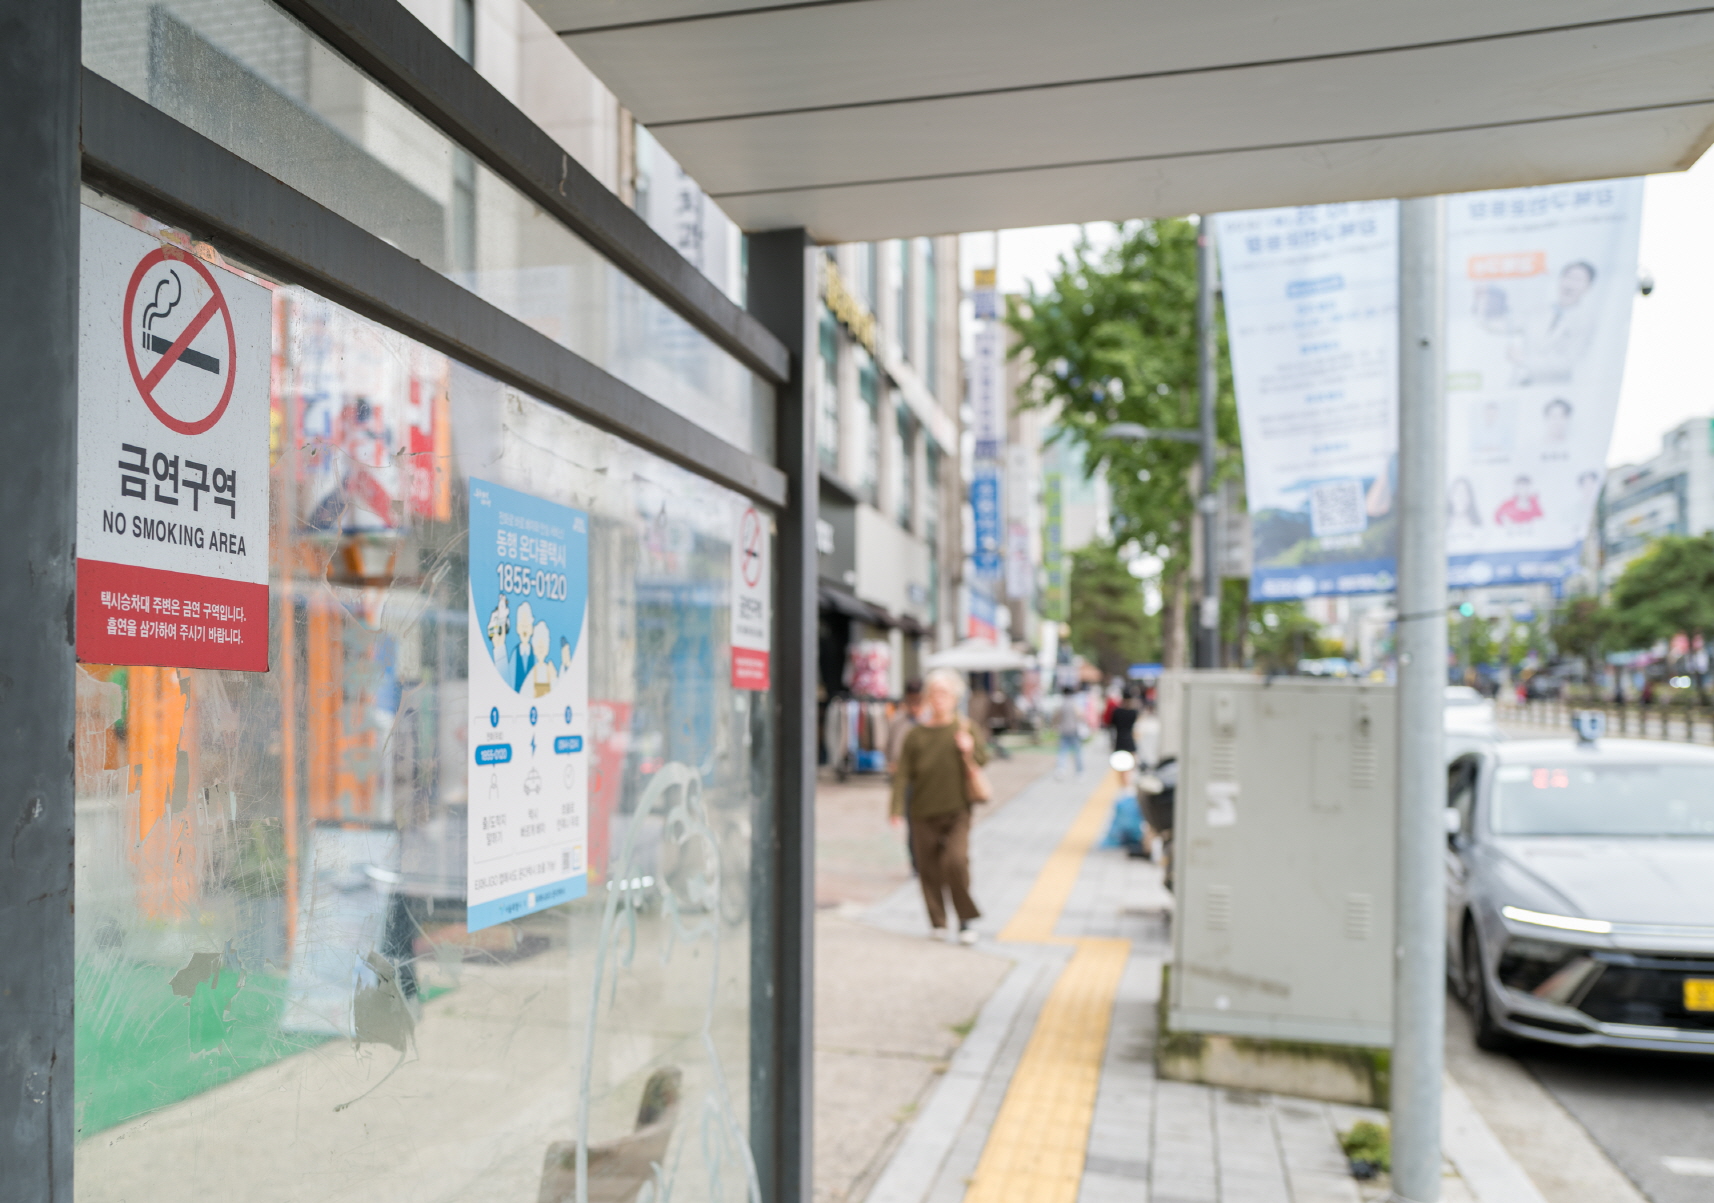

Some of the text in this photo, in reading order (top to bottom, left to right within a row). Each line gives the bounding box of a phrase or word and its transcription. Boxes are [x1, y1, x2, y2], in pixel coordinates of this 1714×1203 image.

[118, 442, 236, 520] 금연구역
[103, 509, 247, 556] NO SMOKING AREA
[496, 529, 518, 559] 동행
[496, 562, 568, 602] 1855-0120
[100, 591, 247, 622] 택시승차대 주변은 금연 구역입니다.
[106, 617, 244, 645] 흡연을 삼가하여 주시기 바랍니다.
